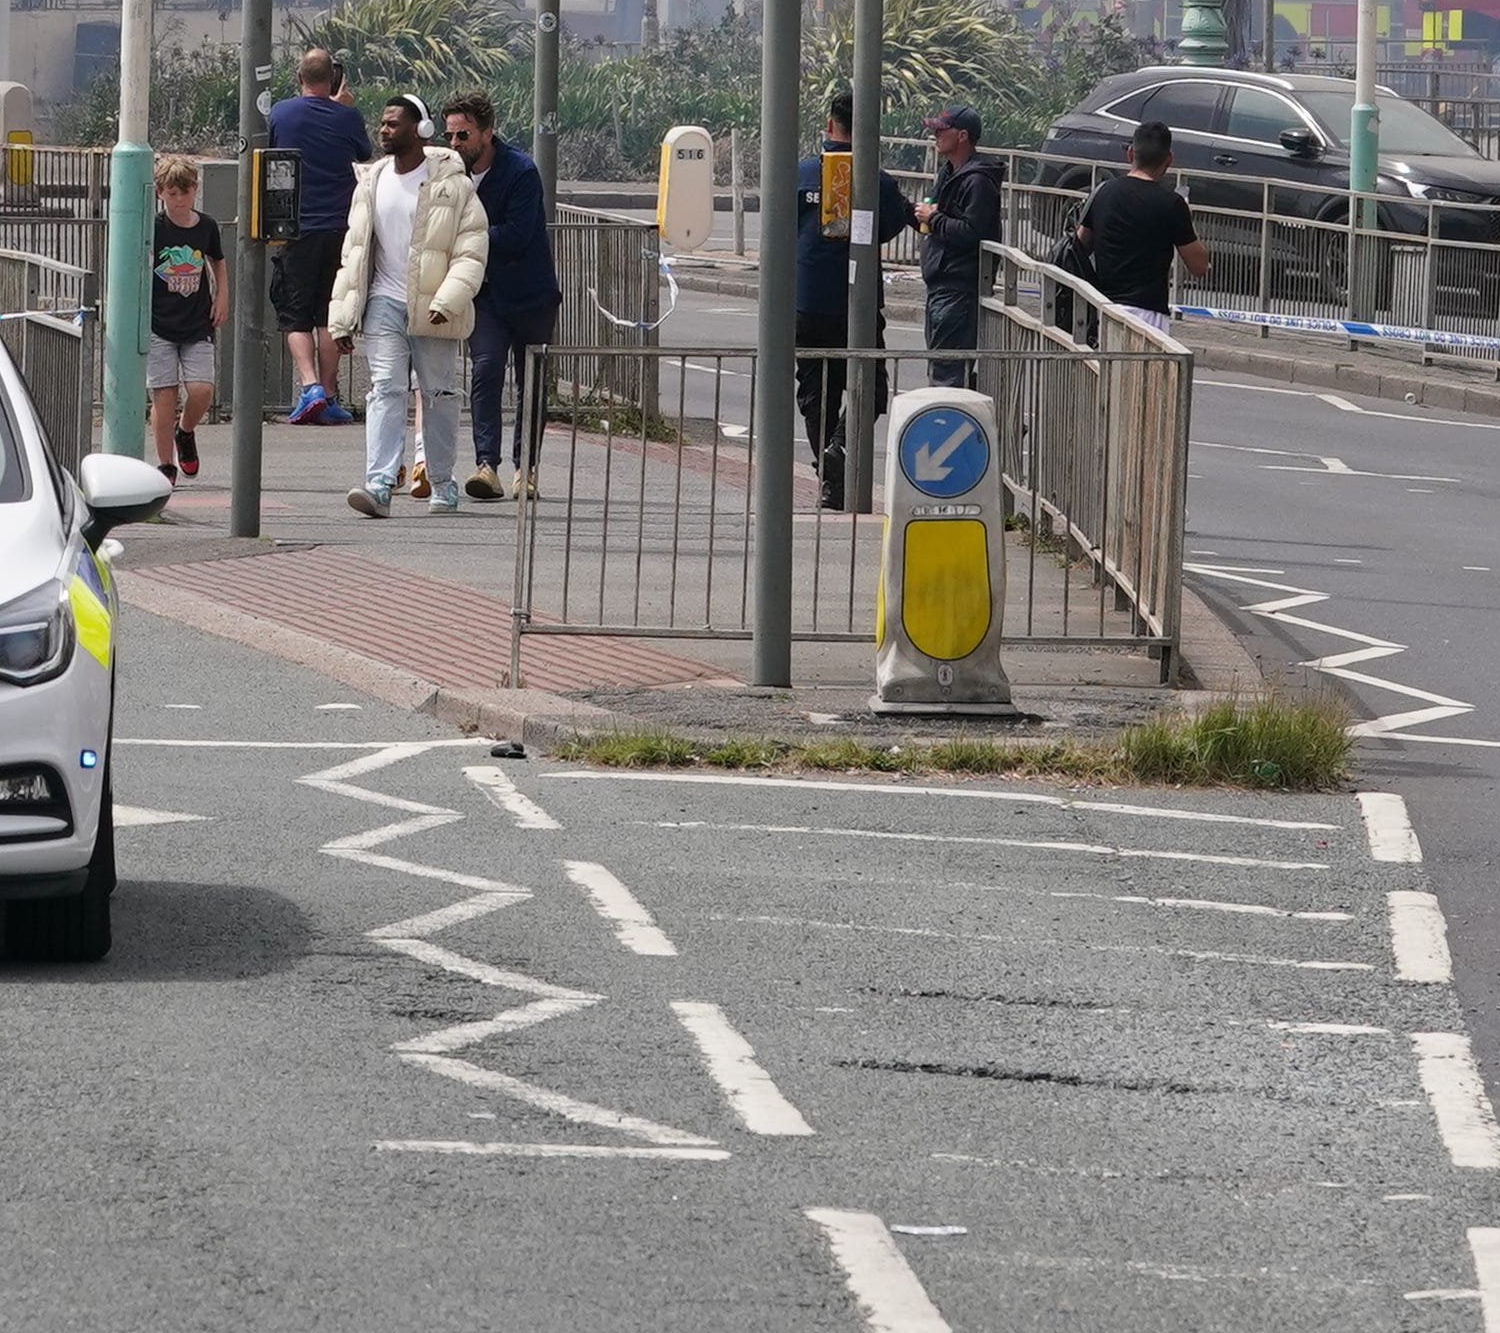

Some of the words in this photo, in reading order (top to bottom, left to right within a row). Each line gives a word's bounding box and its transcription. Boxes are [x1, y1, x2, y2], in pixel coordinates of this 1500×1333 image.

[677, 148, 704, 160] 516
[1218, 310, 1247, 321] CROSS
[1251, 314, 1267, 324] NOT
[1270, 316, 1281, 326] DO
[1285, 317, 1304, 329] LINE
[1306, 318, 1337, 332] POLICE
[1382, 327, 1412, 339] CROSS
[1414, 330, 1431, 341] NOT
[1434, 332, 1446, 343] DO
[1449, 335, 1468, 345] LINE
[1470, 336, 1500, 349] POLICE
